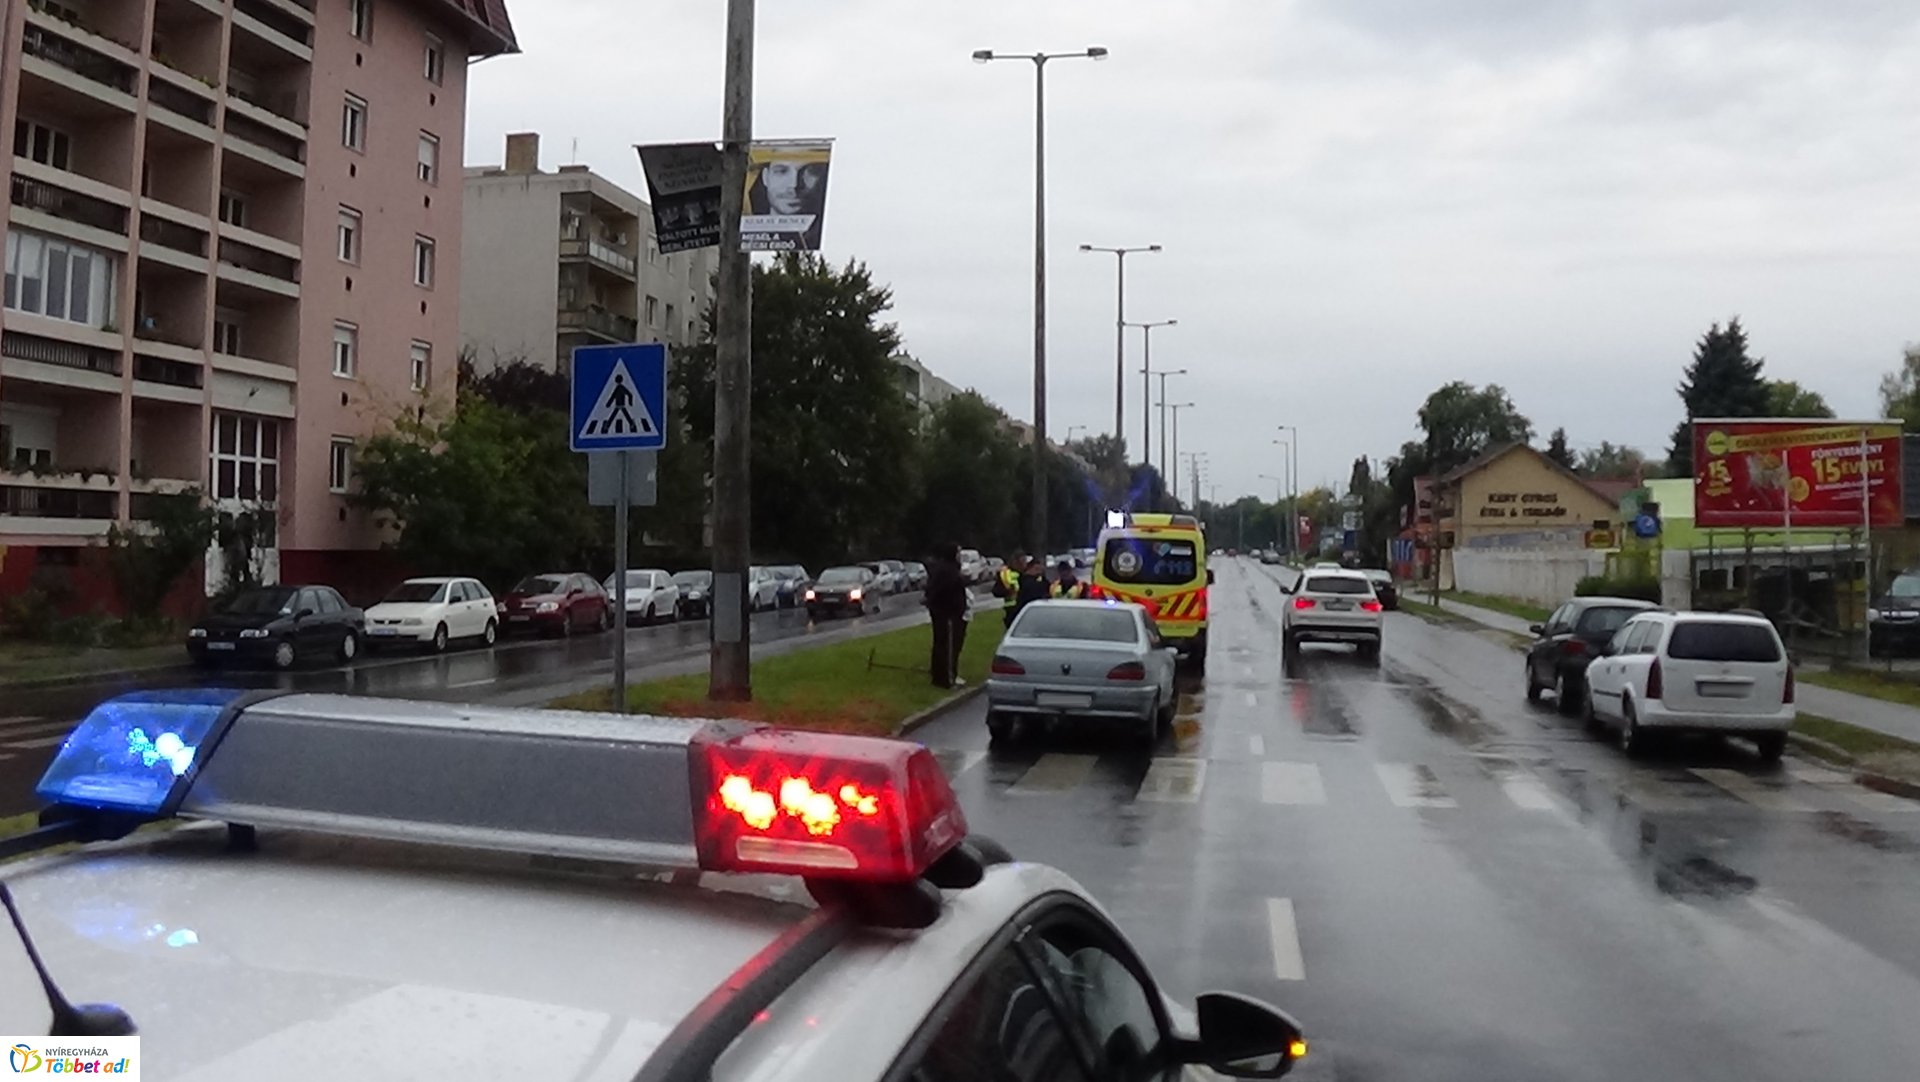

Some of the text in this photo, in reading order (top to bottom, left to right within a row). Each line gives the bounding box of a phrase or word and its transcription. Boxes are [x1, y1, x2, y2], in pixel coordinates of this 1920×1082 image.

[1811, 444, 1883, 459] FŐNYEREMNY
[1811, 457, 1884, 483] 15 ÉVYI
